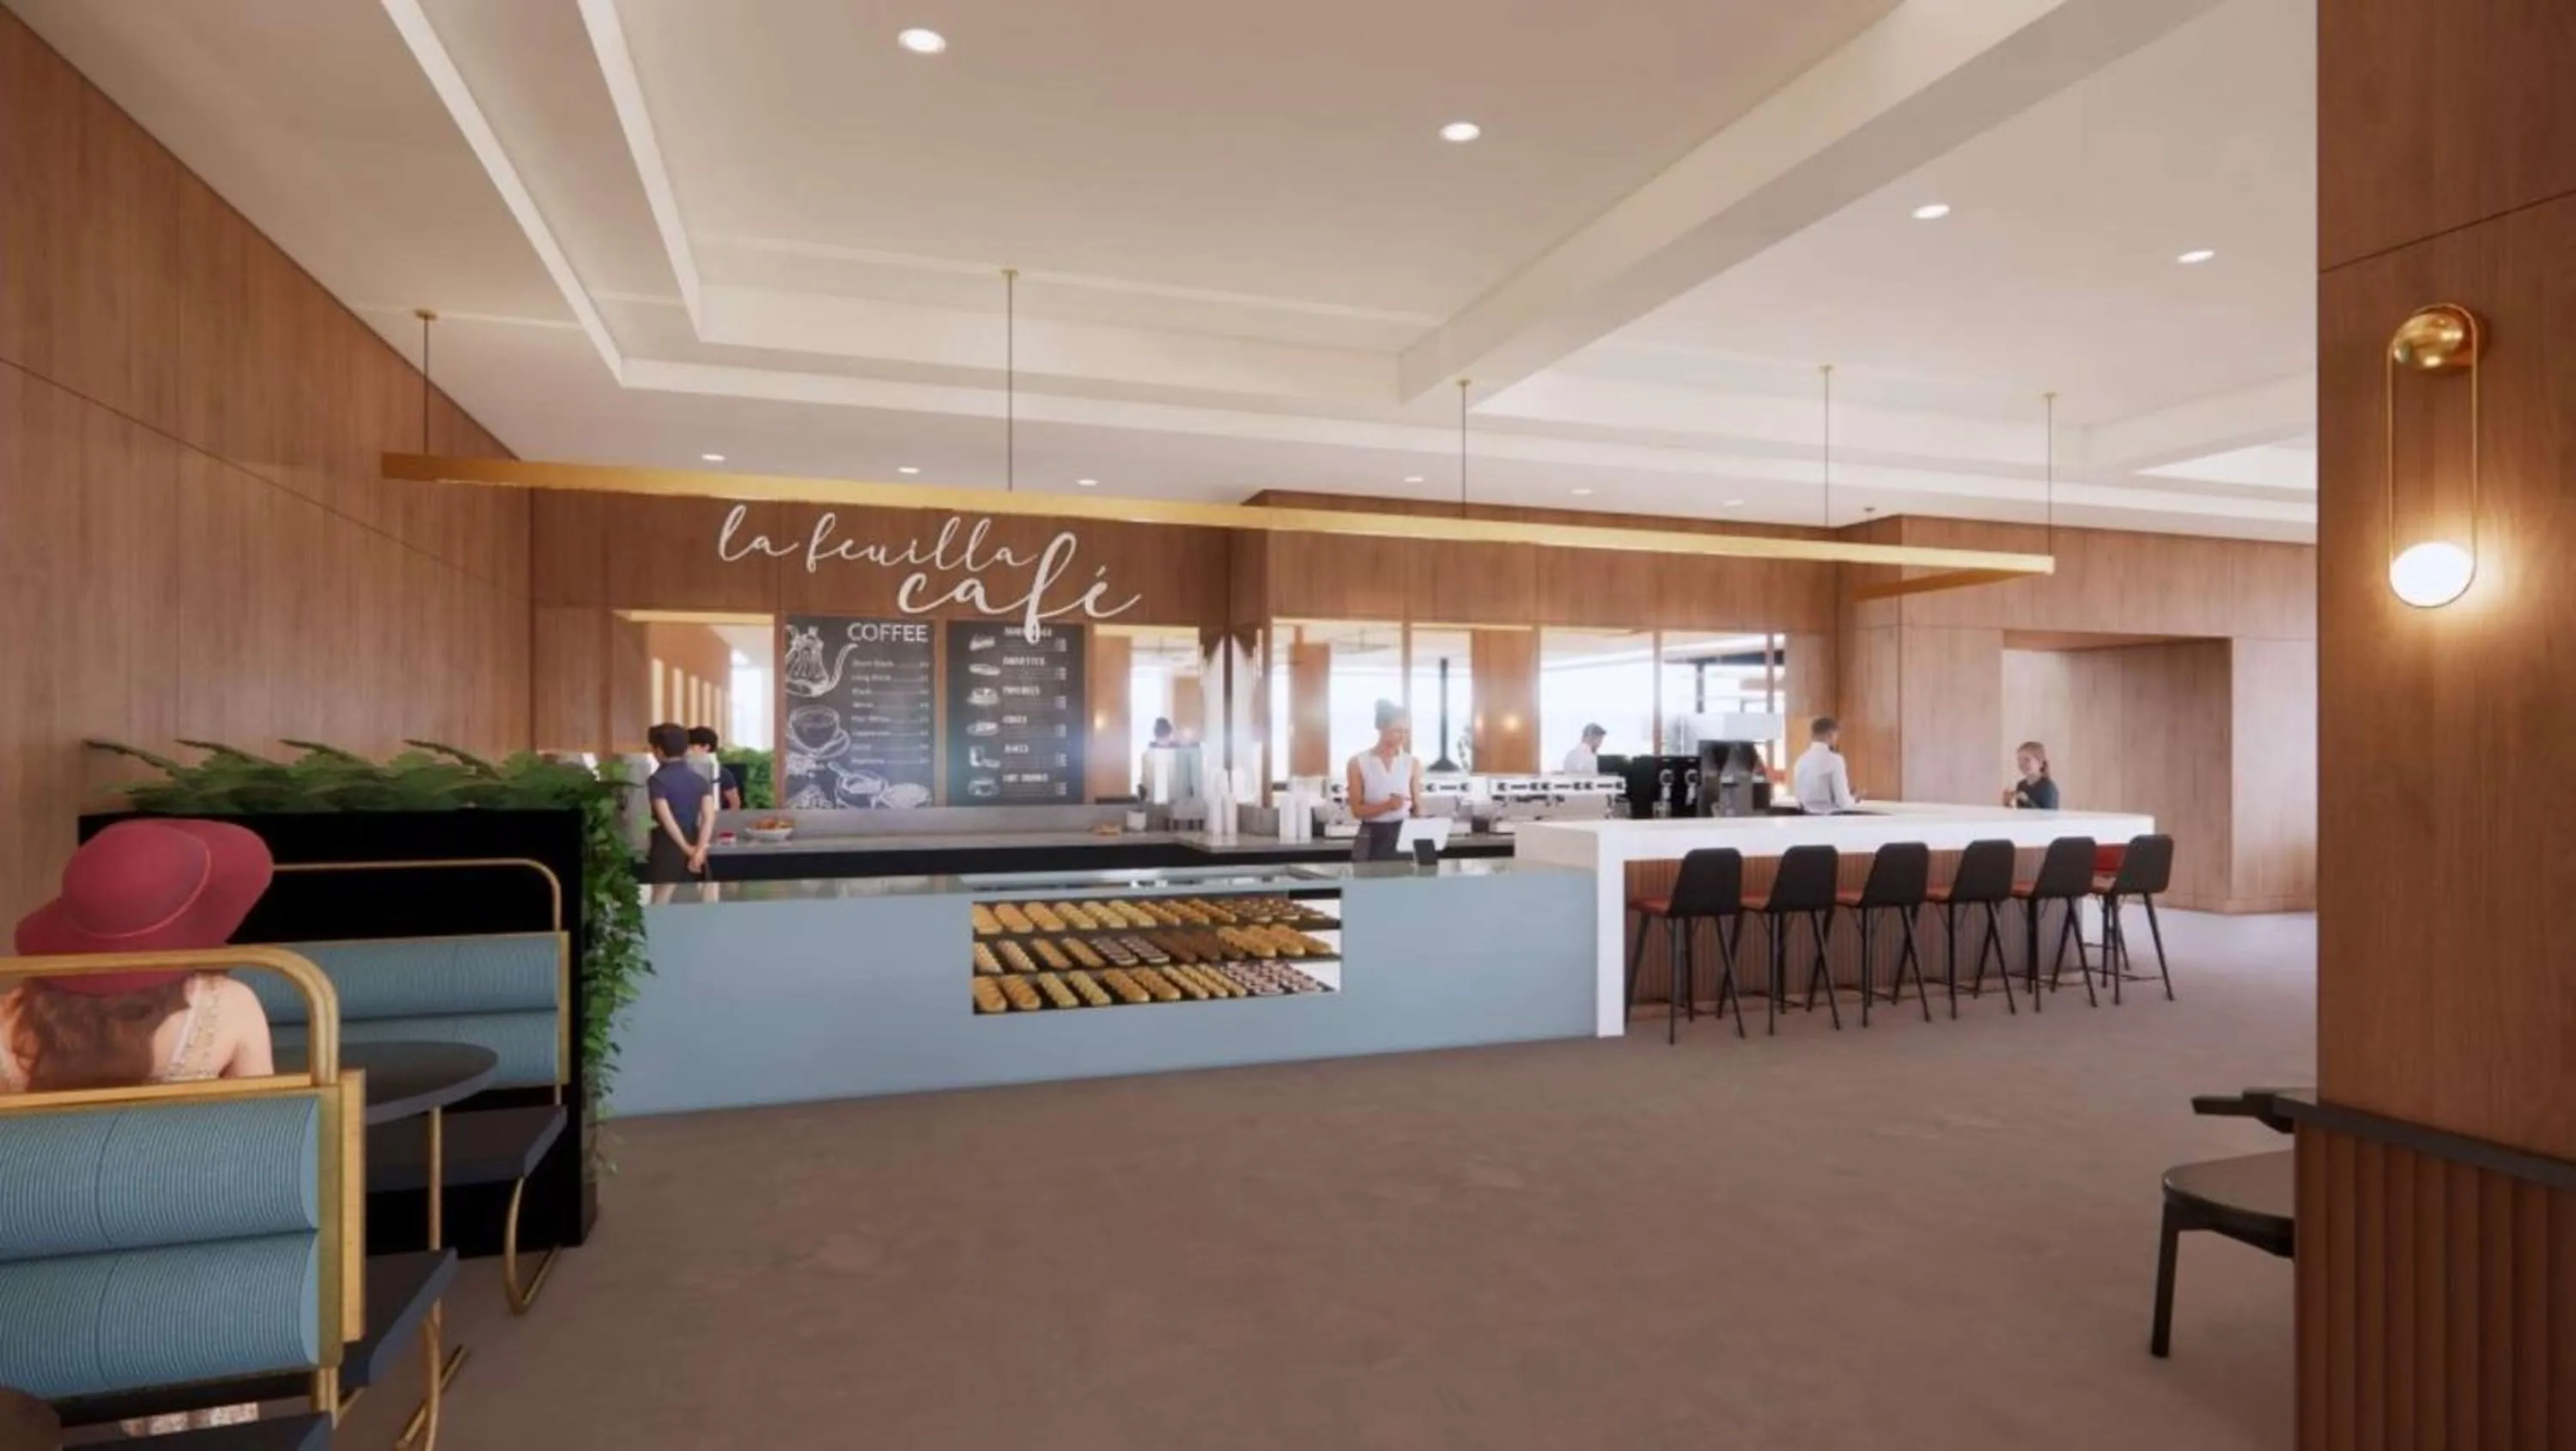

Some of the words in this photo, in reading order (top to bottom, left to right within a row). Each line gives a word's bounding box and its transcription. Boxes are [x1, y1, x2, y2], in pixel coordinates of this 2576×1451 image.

[718, 504, 799, 562] la
[806, 513, 1038, 574] feuilla
[897, 531, 1141, 643] café
[846, 622, 929, 643] COFFEE
